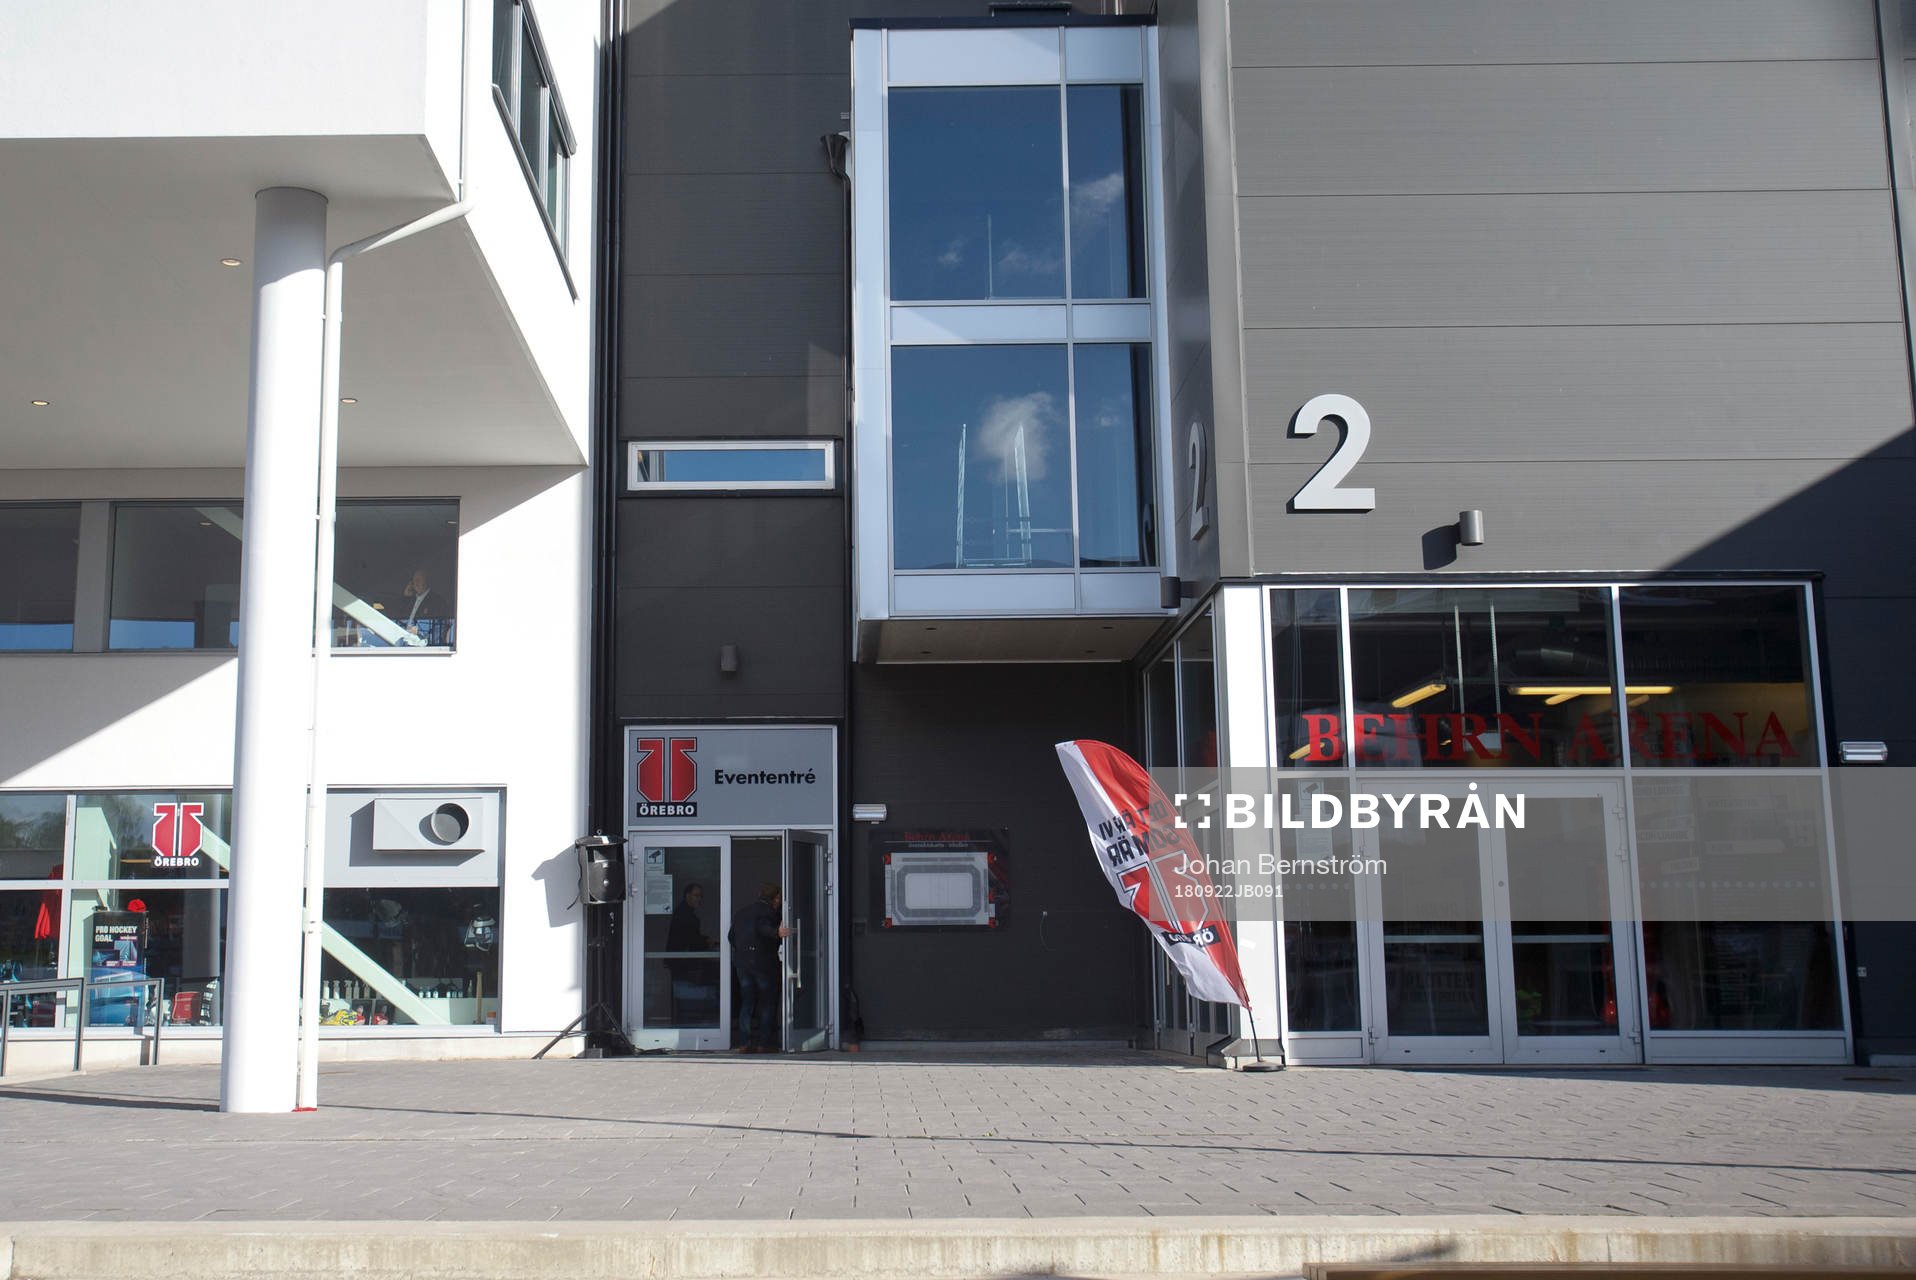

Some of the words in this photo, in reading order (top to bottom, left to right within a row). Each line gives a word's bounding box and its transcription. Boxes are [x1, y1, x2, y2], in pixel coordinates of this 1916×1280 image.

[1287, 394, 1376, 513] 2
[1188, 421, 1210, 541] 2
[1302, 711, 1543, 763] BEHRN
[1567, 711, 1798, 763] ARENA
[714, 768, 816, 786] Evententré
[639, 803, 695, 816] ÖREBRO
[154, 855, 200, 868] ÖREBRO
[95, 925, 108, 934] PRO
[109, 925, 138, 934] HOCKEY
[95, 934, 113, 942] GOAL
